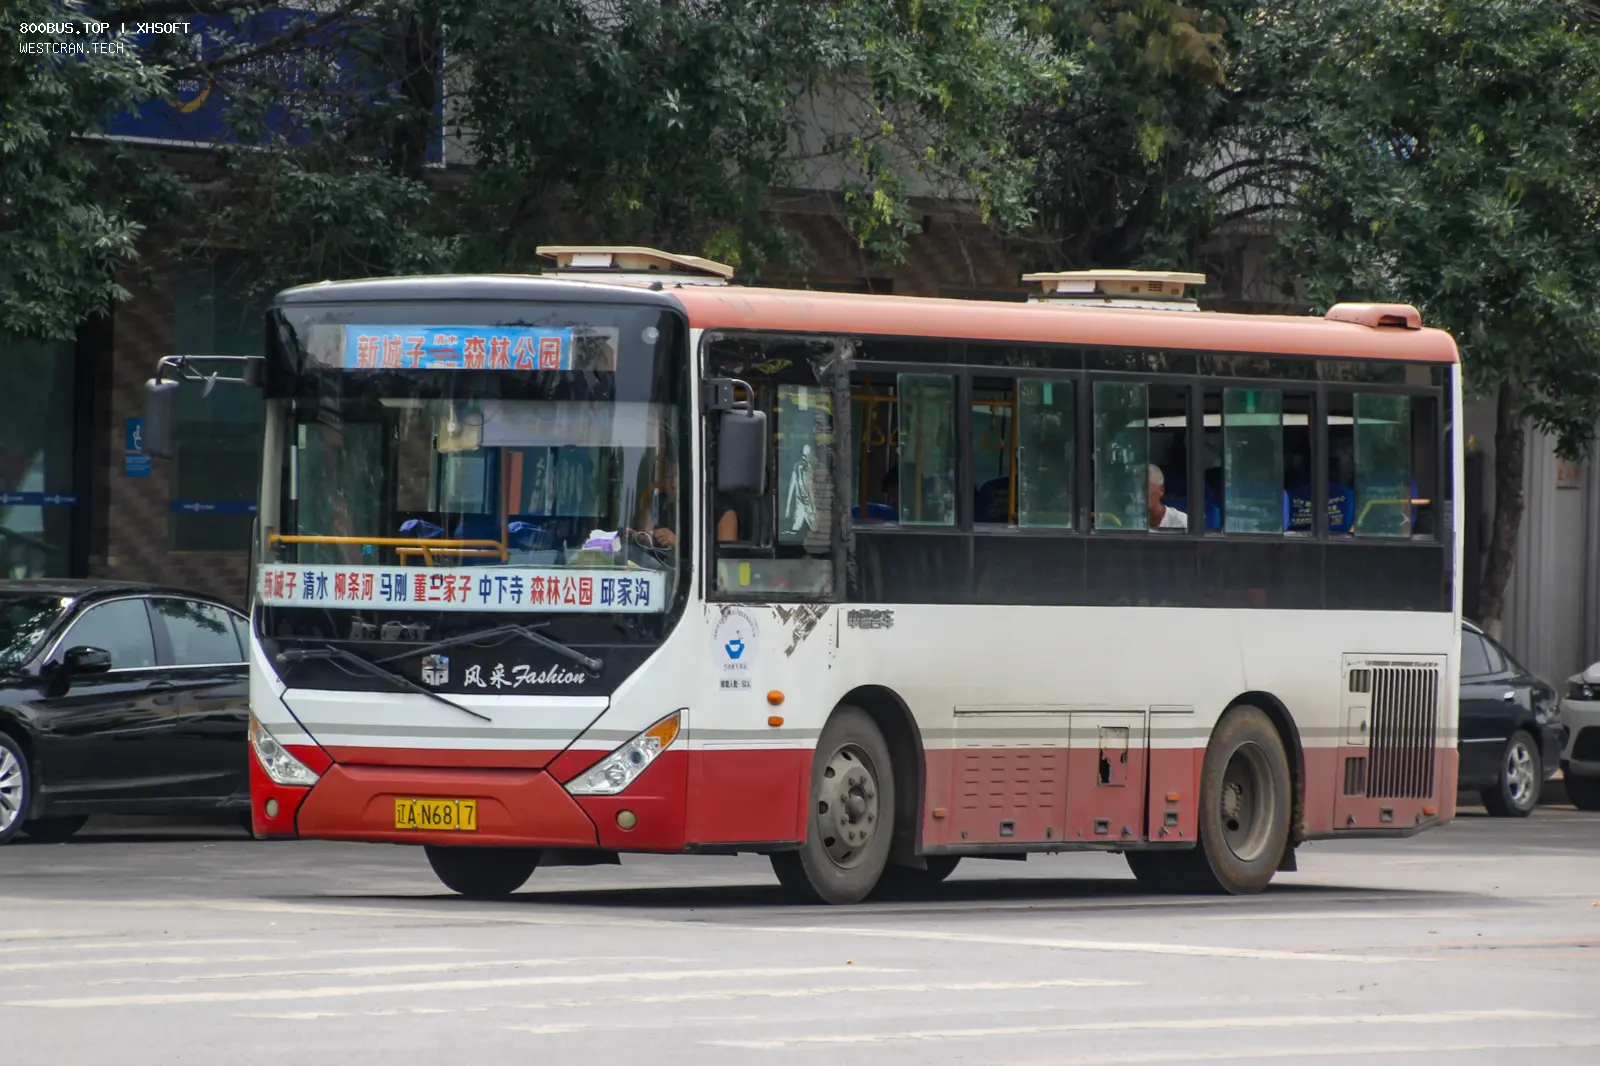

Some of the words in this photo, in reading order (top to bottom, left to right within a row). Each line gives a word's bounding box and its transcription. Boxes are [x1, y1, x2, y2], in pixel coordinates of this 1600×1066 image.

[356, 334, 426, 369] 新城子
[463, 335, 562, 370] 森林公园
[263, 570, 297, 599] 新城子
[302, 571, 329, 600] 清水
[334, 571, 374, 601] 柳条河
[379, 573, 407, 602] 马刚
[478, 574, 524, 604] 中下寺
[530, 575, 593, 606] 森林公园
[600, 577, 650, 606] 邱家沟
